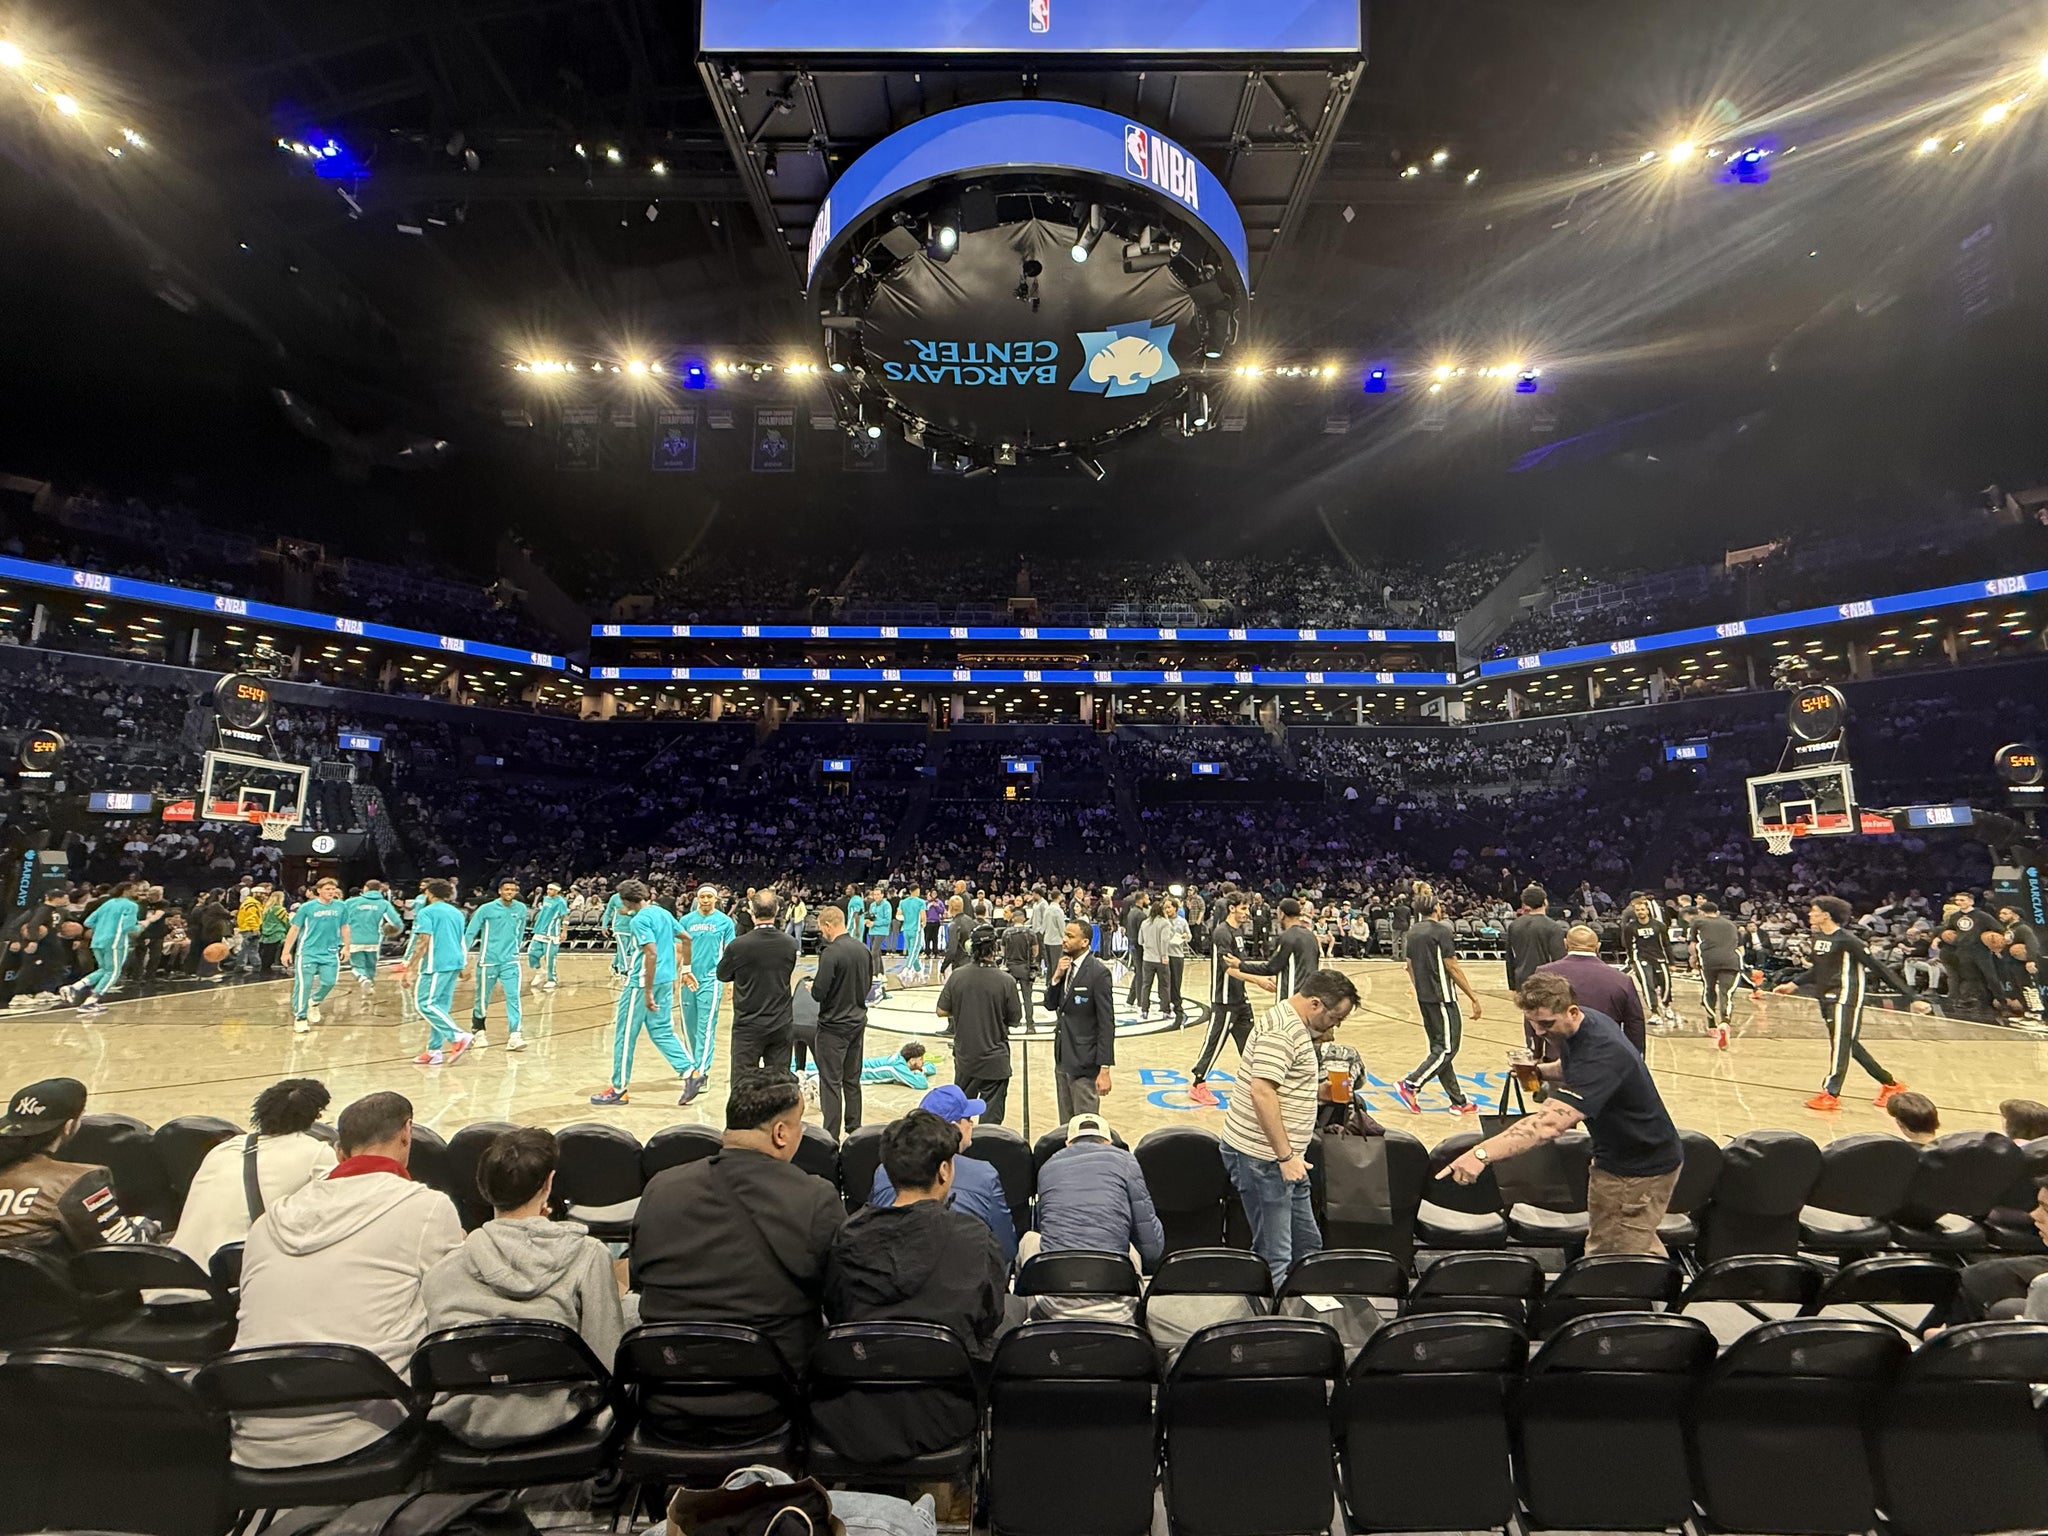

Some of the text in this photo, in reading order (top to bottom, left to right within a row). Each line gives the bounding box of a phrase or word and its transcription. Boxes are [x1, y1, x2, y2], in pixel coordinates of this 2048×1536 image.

[1151, 135, 1199, 211] NBA
[909, 339, 1059, 363] CENTER
[882, 361, 1058, 386] BARCLAYS
[84, 574, 111, 592] NBA
[1997, 575, 2028, 594] NBA
[223, 598, 247, 615] NBA
[1850, 600, 1875, 618] NBA
[344, 618, 364, 635] NBA
[1724, 620, 1747, 638] NBA
[447, 636, 465, 652] NBA
[1617, 639, 1637, 654] NBA
[237, 684, 266, 702] 5:44
[1801, 695, 1831, 713] 5:44
[17, 861, 34, 907] BARCLAYS
[2028, 878, 2045, 925] BARCLAYS
